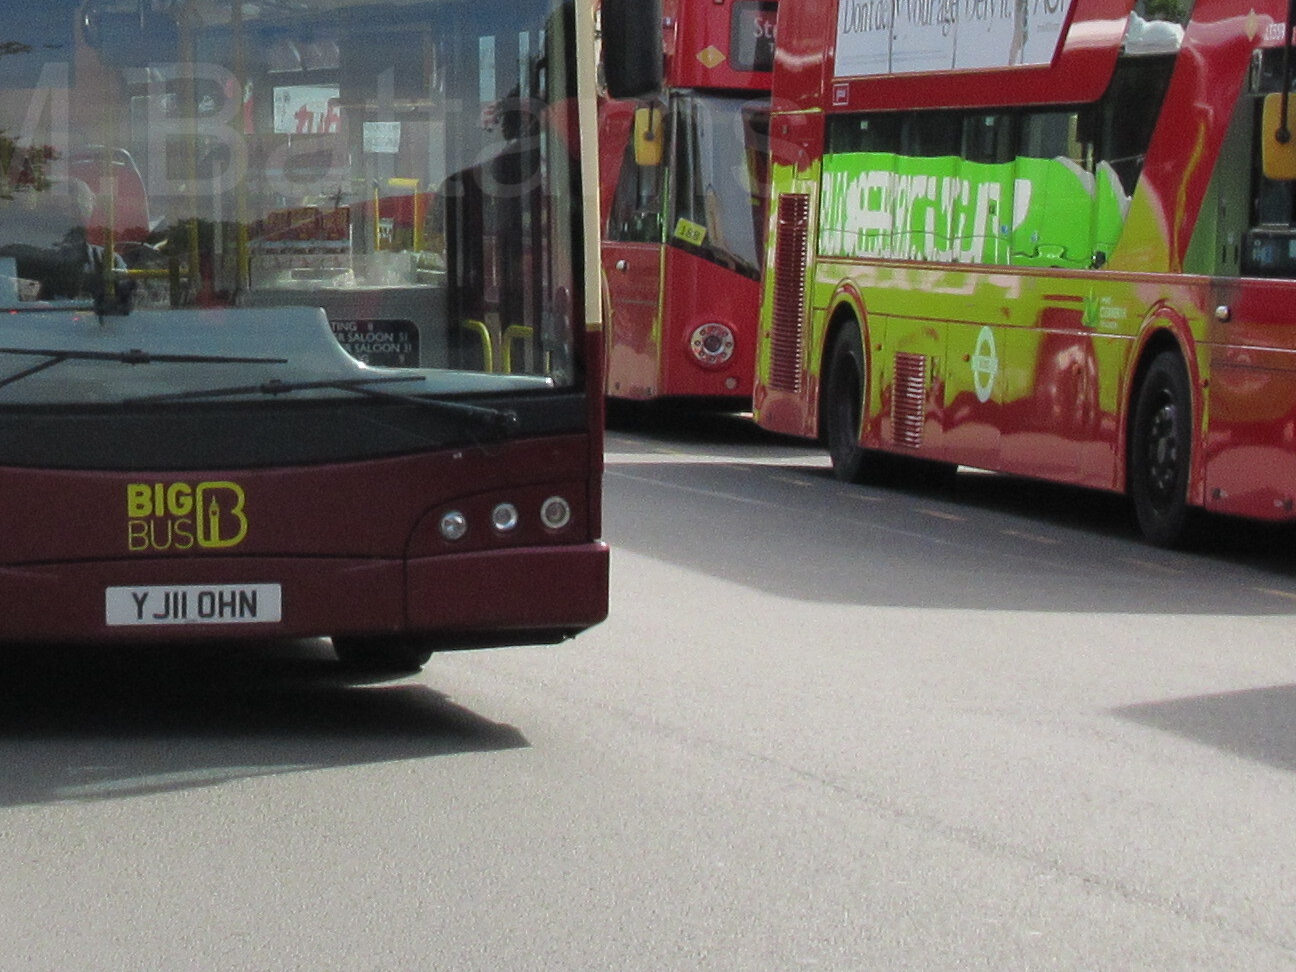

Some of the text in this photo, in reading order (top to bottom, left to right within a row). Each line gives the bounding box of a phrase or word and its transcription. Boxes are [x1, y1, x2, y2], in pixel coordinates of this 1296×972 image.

[347, 332, 394, 343] SALOON
[354, 343, 401, 353] SALOON
[127, 482, 193, 517] BIG
[128, 519, 194, 551] BUS
[131, 589, 257, 620] YJ11 OHN
